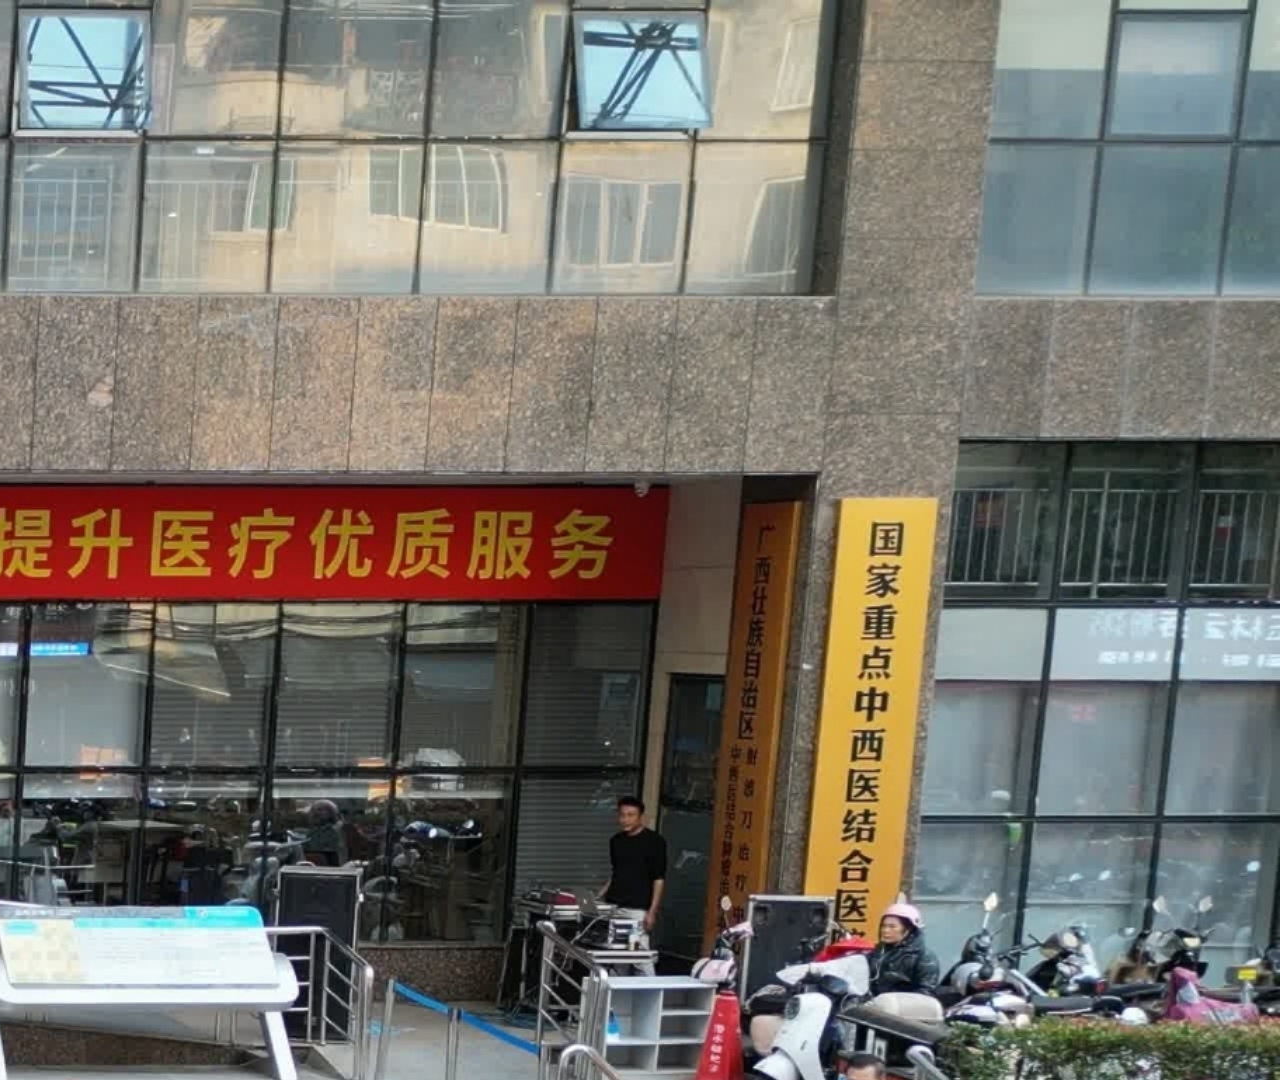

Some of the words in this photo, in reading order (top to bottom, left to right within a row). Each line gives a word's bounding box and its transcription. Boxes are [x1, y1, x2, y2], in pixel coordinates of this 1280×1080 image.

[831, 522, 905, 938] 国家重点中西医结合医
